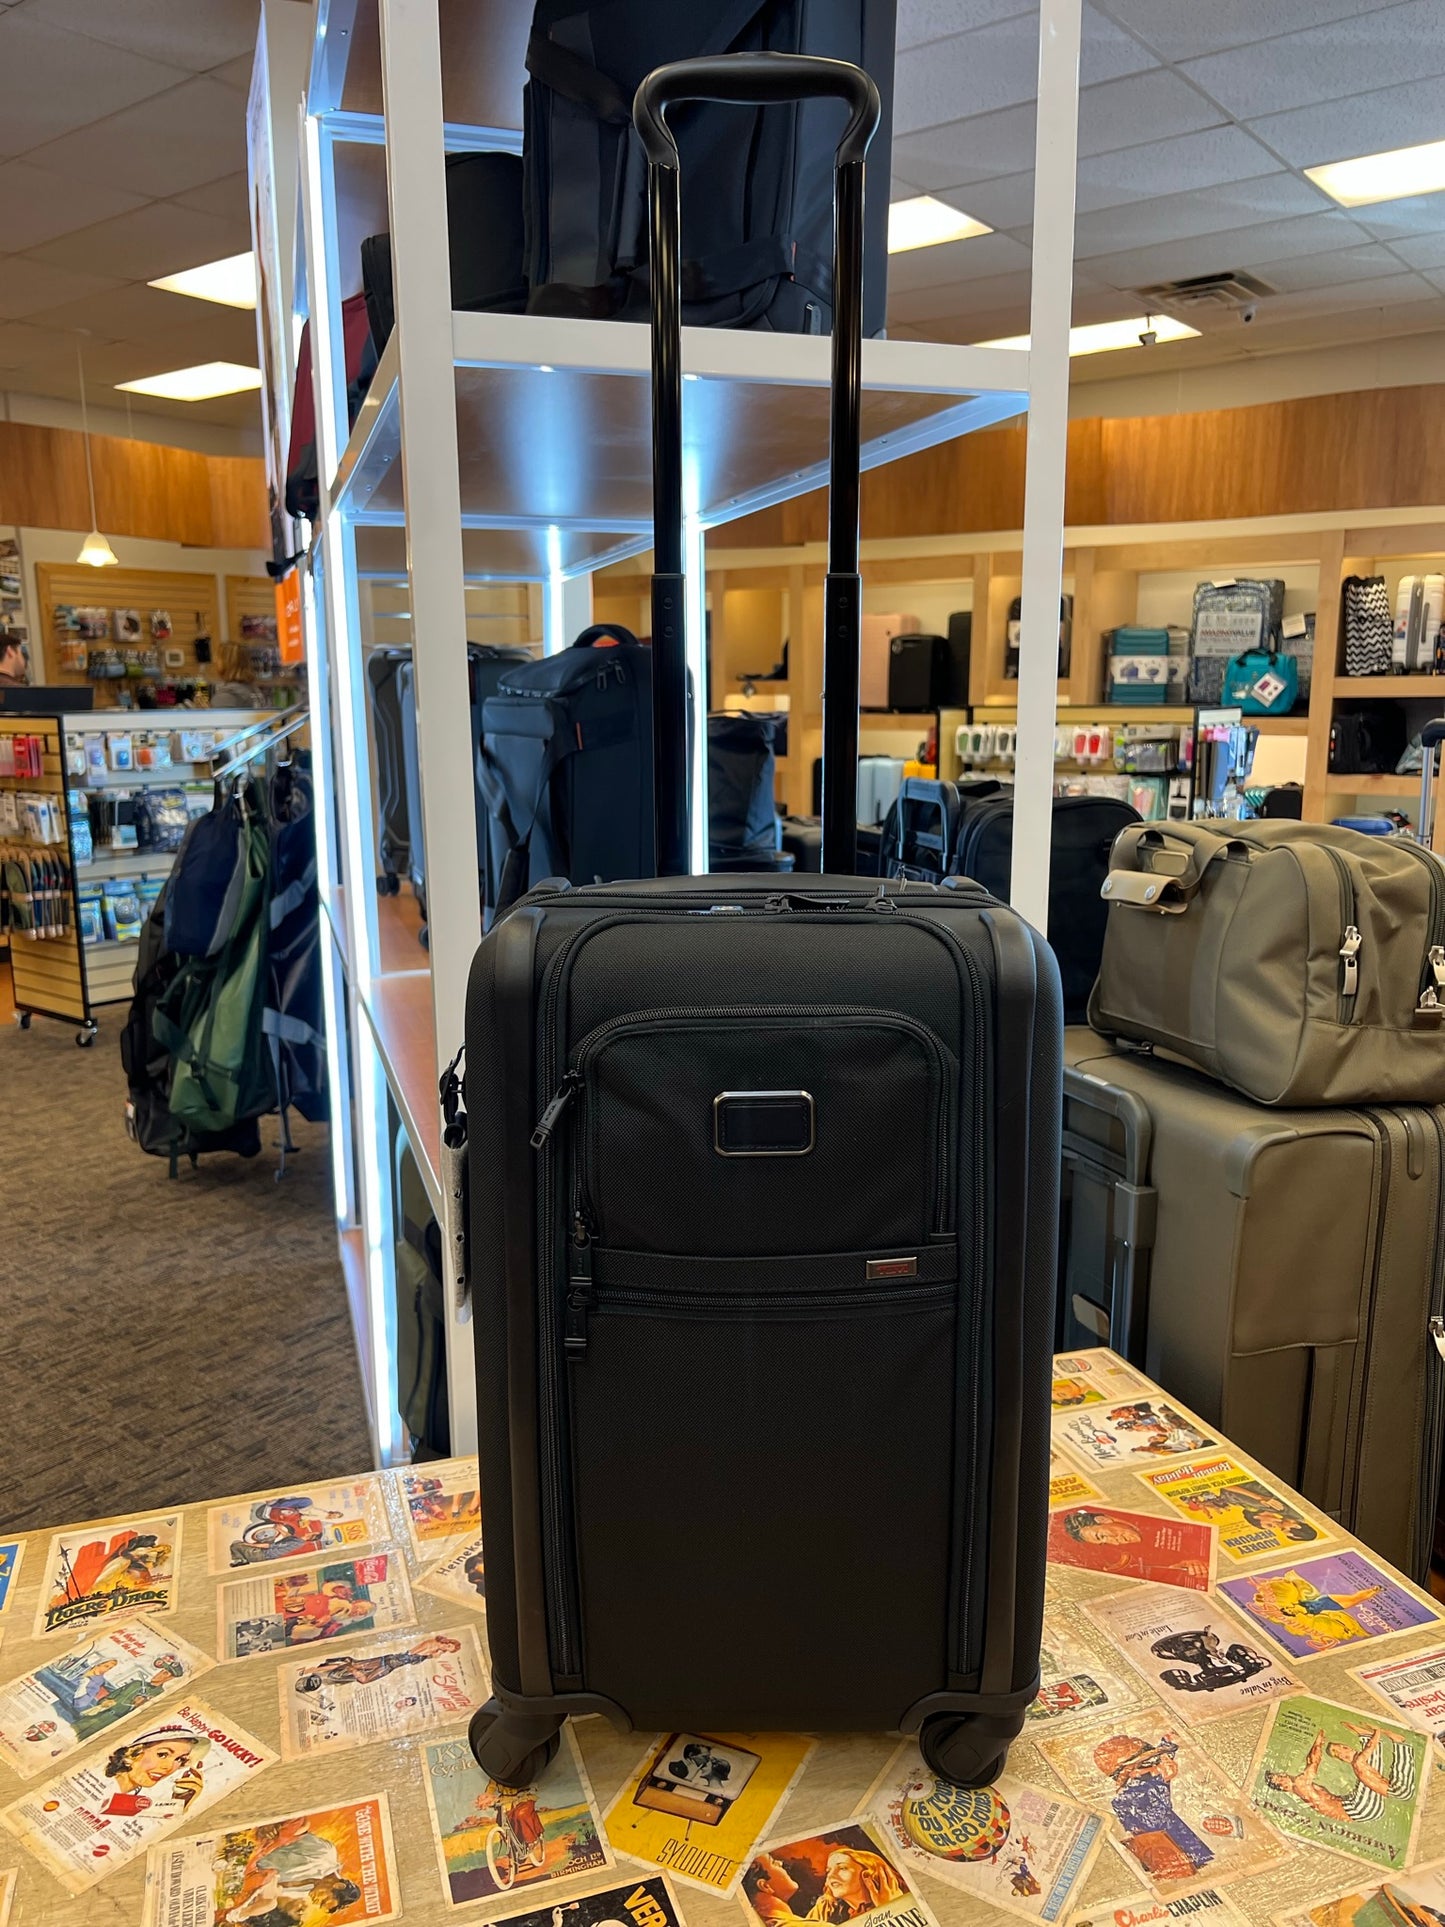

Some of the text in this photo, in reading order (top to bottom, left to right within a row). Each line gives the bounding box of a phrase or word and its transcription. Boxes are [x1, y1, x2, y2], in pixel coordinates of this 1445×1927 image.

[1152, 1462, 1232, 1485] Roman Holiday
[1222, 1529, 1276, 1548] HEPBURN
[1236, 1537, 1281, 1555] AUDREY
[435, 1535, 482, 1576] Heineke
[1239, 1681, 1266, 1697] Value
[1269, 1675, 1293, 1689] Big
[177, 1704, 191, 1717] Be
[908, 1801, 929, 1817] LE
[918, 1816, 943, 1832] DU
[943, 1788, 973, 1829] MOND
[928, 1831, 957, 1848] EN
[951, 1821, 980, 1843] 80
[977, 1790, 992, 1829] JOURS
[357, 1834, 376, 1862] WITH
[1316, 1820, 1402, 1862] AMERICAN
[171, 1850, 183, 1871] LESLIE
[550, 1858, 604, 1878] BIRMINGHAM
[655, 1837, 736, 1886] SYLOUETTE
[169, 1870, 182, 1898] HOWARD
[361, 1860, 377, 1885] THE
[195, 1885, 207, 1906] CLARK
[623, 1885, 670, 1927] VER
[863, 1909, 894, 1927] Joan
[1113, 1888, 1224, 1927] Charlie CHAPLIN
